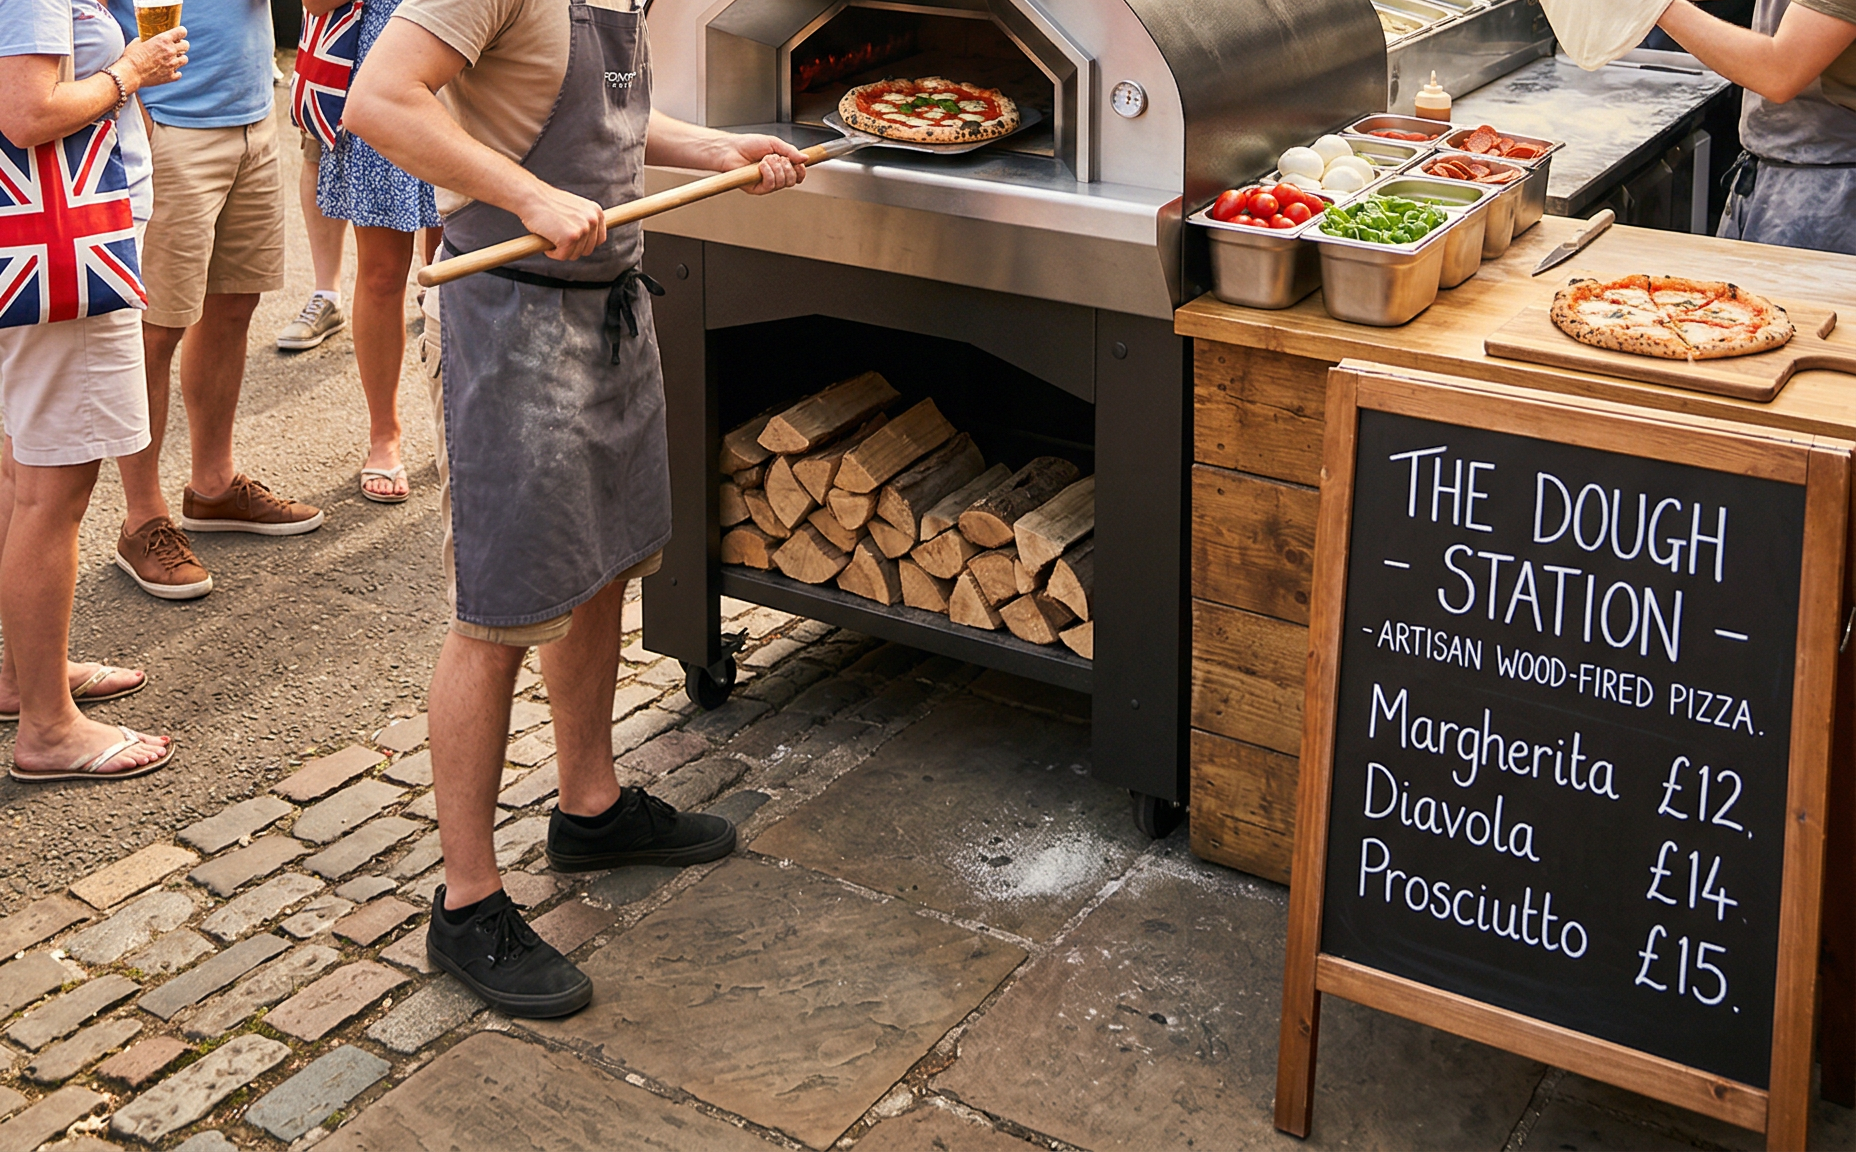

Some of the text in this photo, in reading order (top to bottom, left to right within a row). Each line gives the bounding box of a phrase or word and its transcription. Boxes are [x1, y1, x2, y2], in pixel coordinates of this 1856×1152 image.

[1390, 445, 1727, 583] THE DOUGH
[1437, 544, 1683, 663] STATION
[1496, 644, 1654, 708] WOOD-FIRED
[1369, 683, 1620, 801] Margherita
[1364, 762, 1540, 862] Diavola
[1359, 837, 1588, 958] Prosciutto
